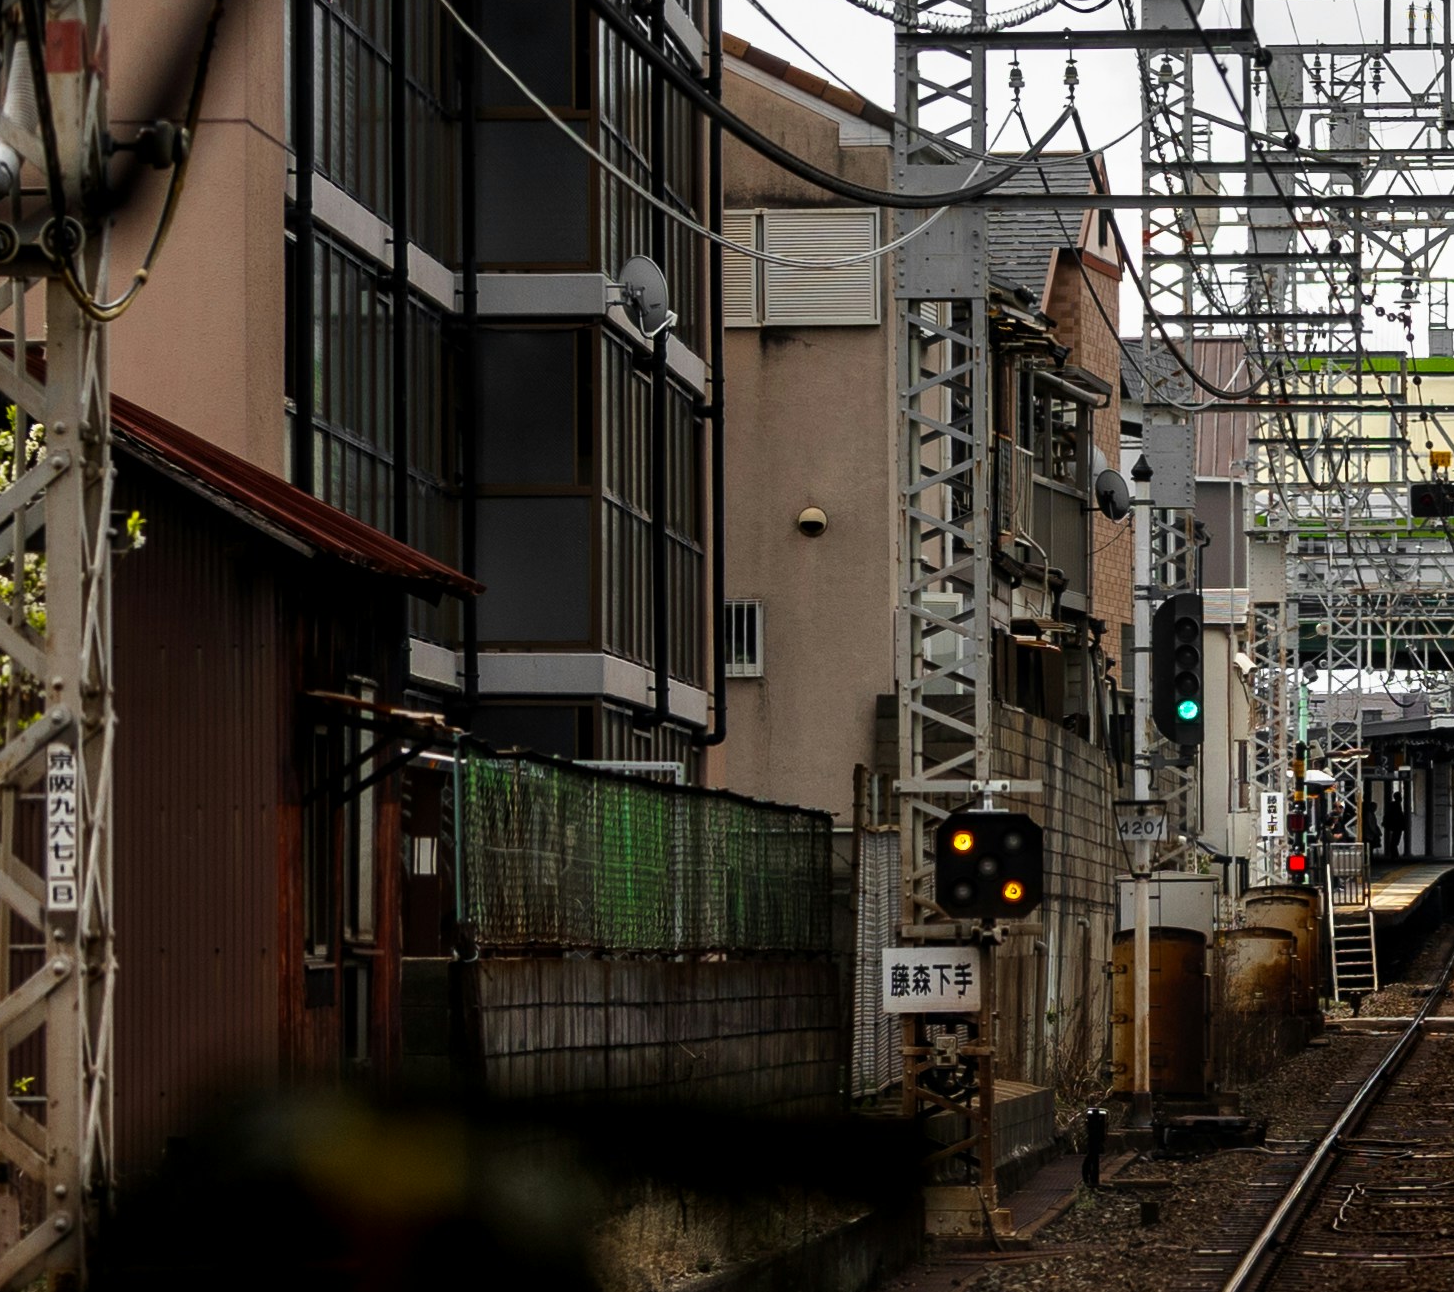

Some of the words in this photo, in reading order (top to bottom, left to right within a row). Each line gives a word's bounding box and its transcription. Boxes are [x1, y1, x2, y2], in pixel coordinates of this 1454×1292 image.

[1118, 820, 1163, 836] 4201
[890, 963, 973, 997] 藤森下手
